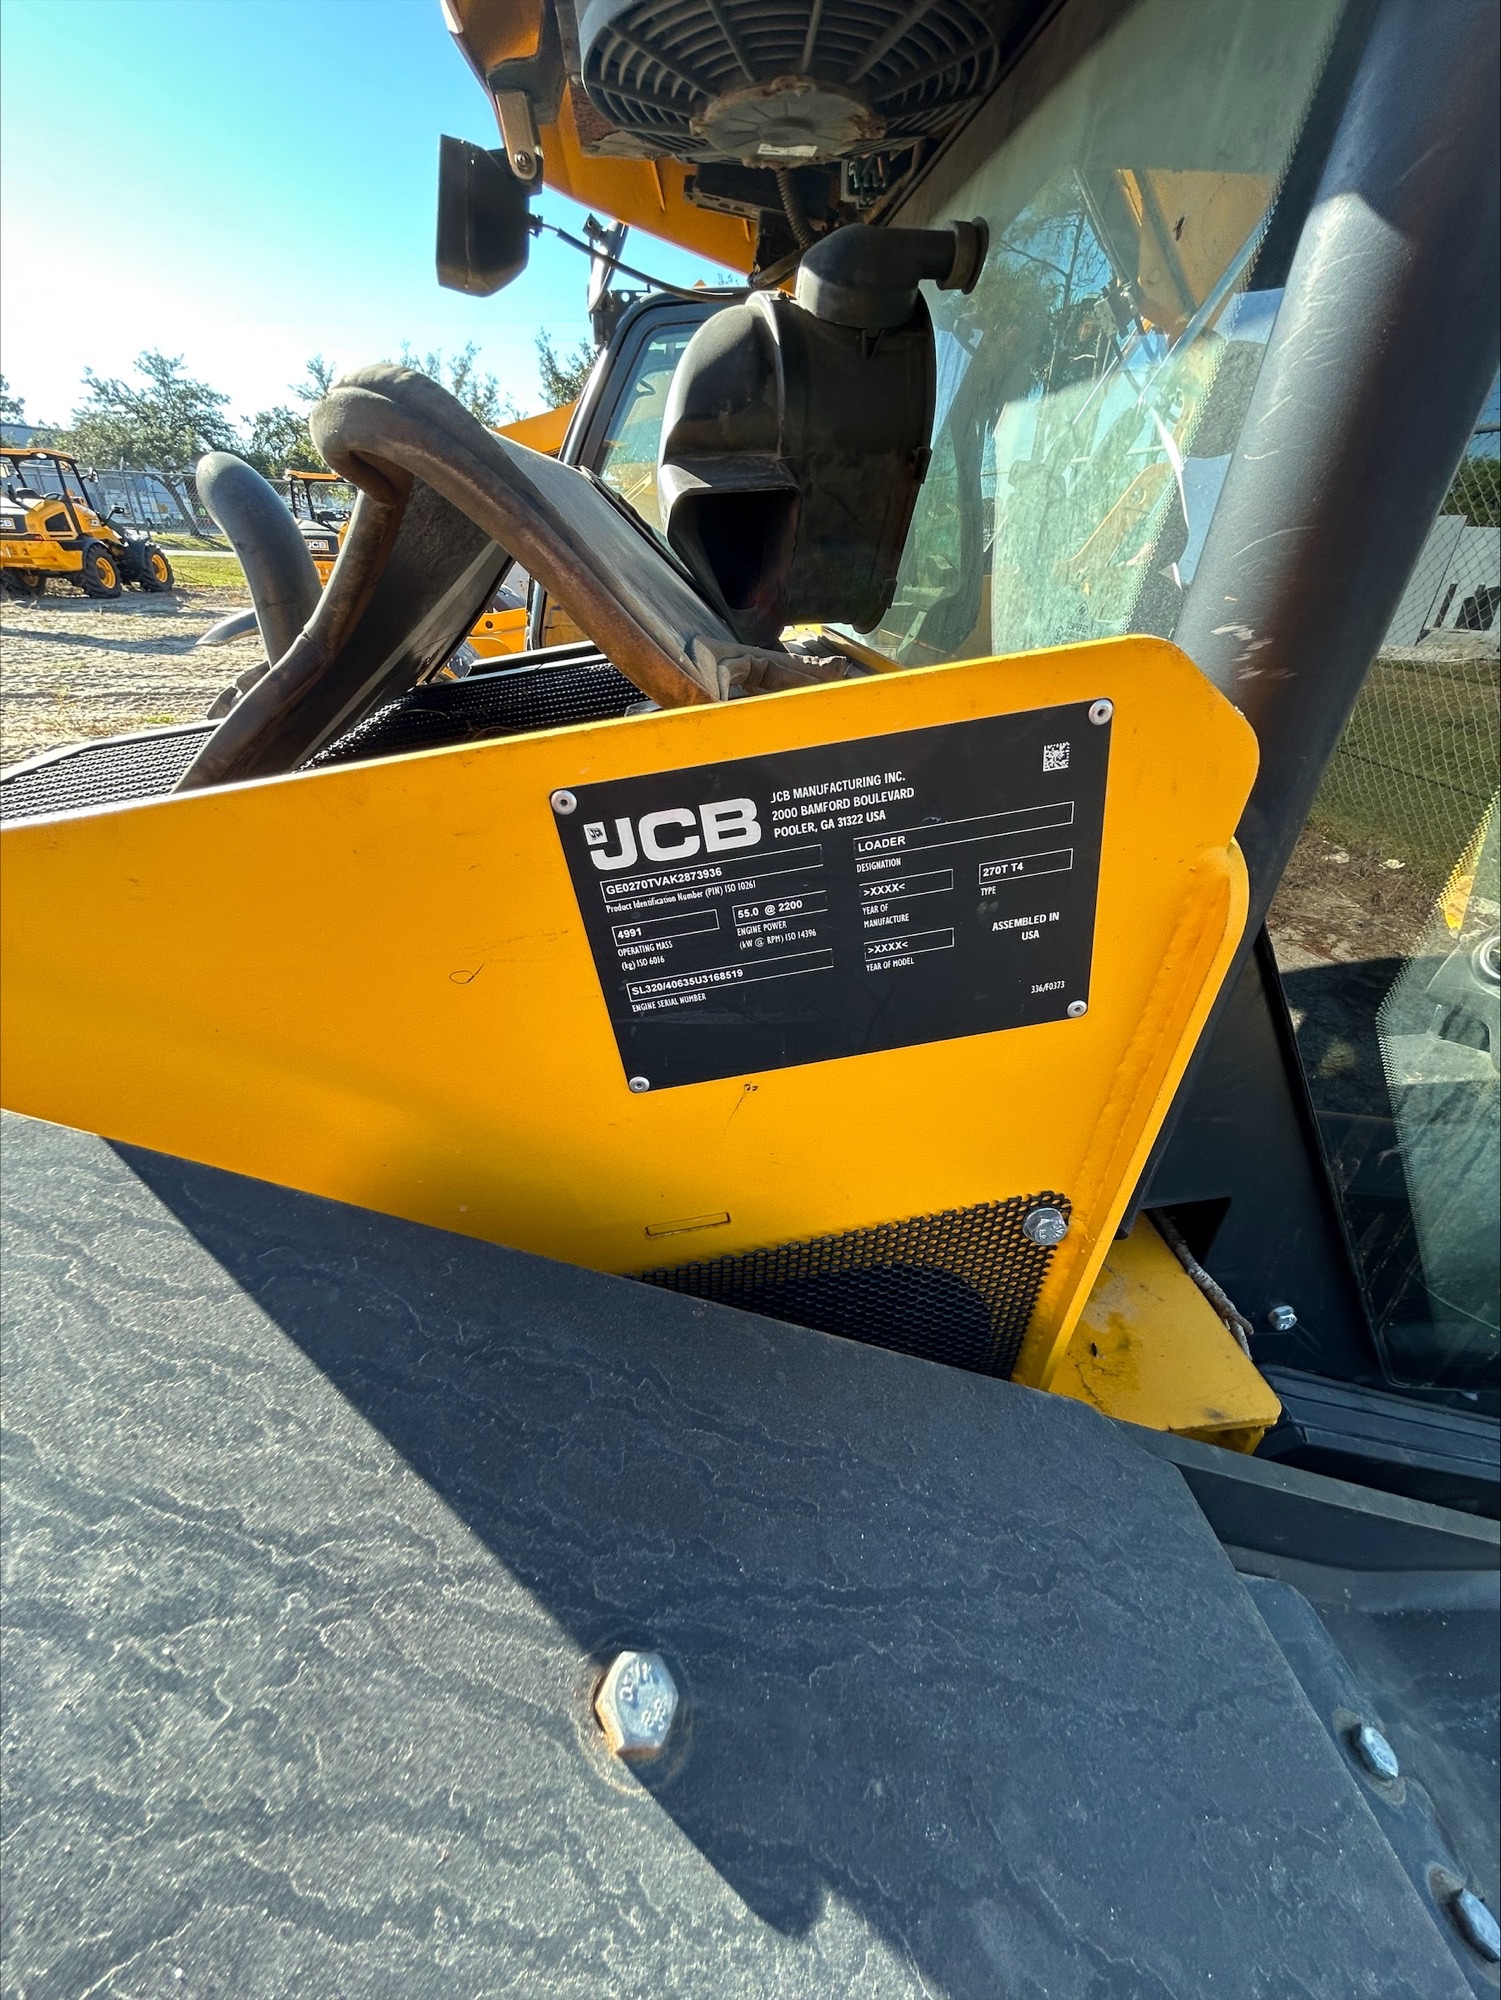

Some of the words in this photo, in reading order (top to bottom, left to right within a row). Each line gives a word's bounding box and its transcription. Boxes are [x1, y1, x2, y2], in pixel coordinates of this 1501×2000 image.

[770, 790, 790, 803] JCB
[793, 774, 881, 799] MANUFACTURING
[884, 771, 905, 784] INC.
[772, 807, 797, 821] 2000
[801, 799, 850, 816] BAMFORD
[853, 787, 914, 807] BOULEVARD
[774, 822, 818, 838] POOLER,
[821, 818, 835, 830] GA
[837, 814, 863, 827] 31322
[866, 810, 886, 822] USA
[584, 798, 761, 870] JCB
[858, 836, 906, 852] LOADER
[856, 858, 901, 873] DESIGNATION
[983, 865, 1008, 877] 270T
[1011, 862, 1024, 872] T4
[606, 867, 722, 895] GE0270TVAK2873936
[606, 903, 632, 913] Product
[633, 895, 676, 909] Identification
[678, 890, 702, 901] Number
[705, 886, 723, 899] (PIN)
[725, 883, 736, 893] ISO
[738, 880, 756, 891] 10261
[863, 883, 905, 896] >XXXX<
[981, 886, 996, 896] TYPE
[737, 906, 759, 919] 55.0
[764, 904, 776, 915] @
[778, 900, 802, 912] 2200
[862, 905, 879, 915] YEAR
[880, 904, 888, 912] OF
[737, 925, 762, 936] ENGINE
[763, 921, 787, 933] POWER
[864, 913, 909, 928] MANUFACTURE
[992, 914, 1046, 931] ASSEMBLED
[1049, 912, 1059, 921] IN
[617, 928, 642, 940] 4991
[739, 939, 752, 950] (kW
[754, 937, 764, 947] @
[767, 934, 784, 945] RPM)
[785, 932, 796, 941] ISO
[797, 929, 817, 939] 14396
[1021, 930, 1039, 940] USA
[618, 944, 655, 957] OPERATING
[656, 940, 673, 950] MASS
[868, 941, 908, 954] >XXXX<
[622, 960, 636, 972] (kg)
[637, 958, 648, 968] ISO
[649, 955, 665, 965] 6016
[866, 962, 881, 972] YEAR
[883, 960, 891, 968] OF
[893, 957, 914, 967] MODEL
[631, 969, 743, 996] SL320/40635U3168519
[1031, 981, 1065, 993] 336/F0373
[632, 1001, 656, 1013] ENGINE
[657, 997, 678, 1008] SERIAL
[679, 993, 707, 1005] NUMBER
